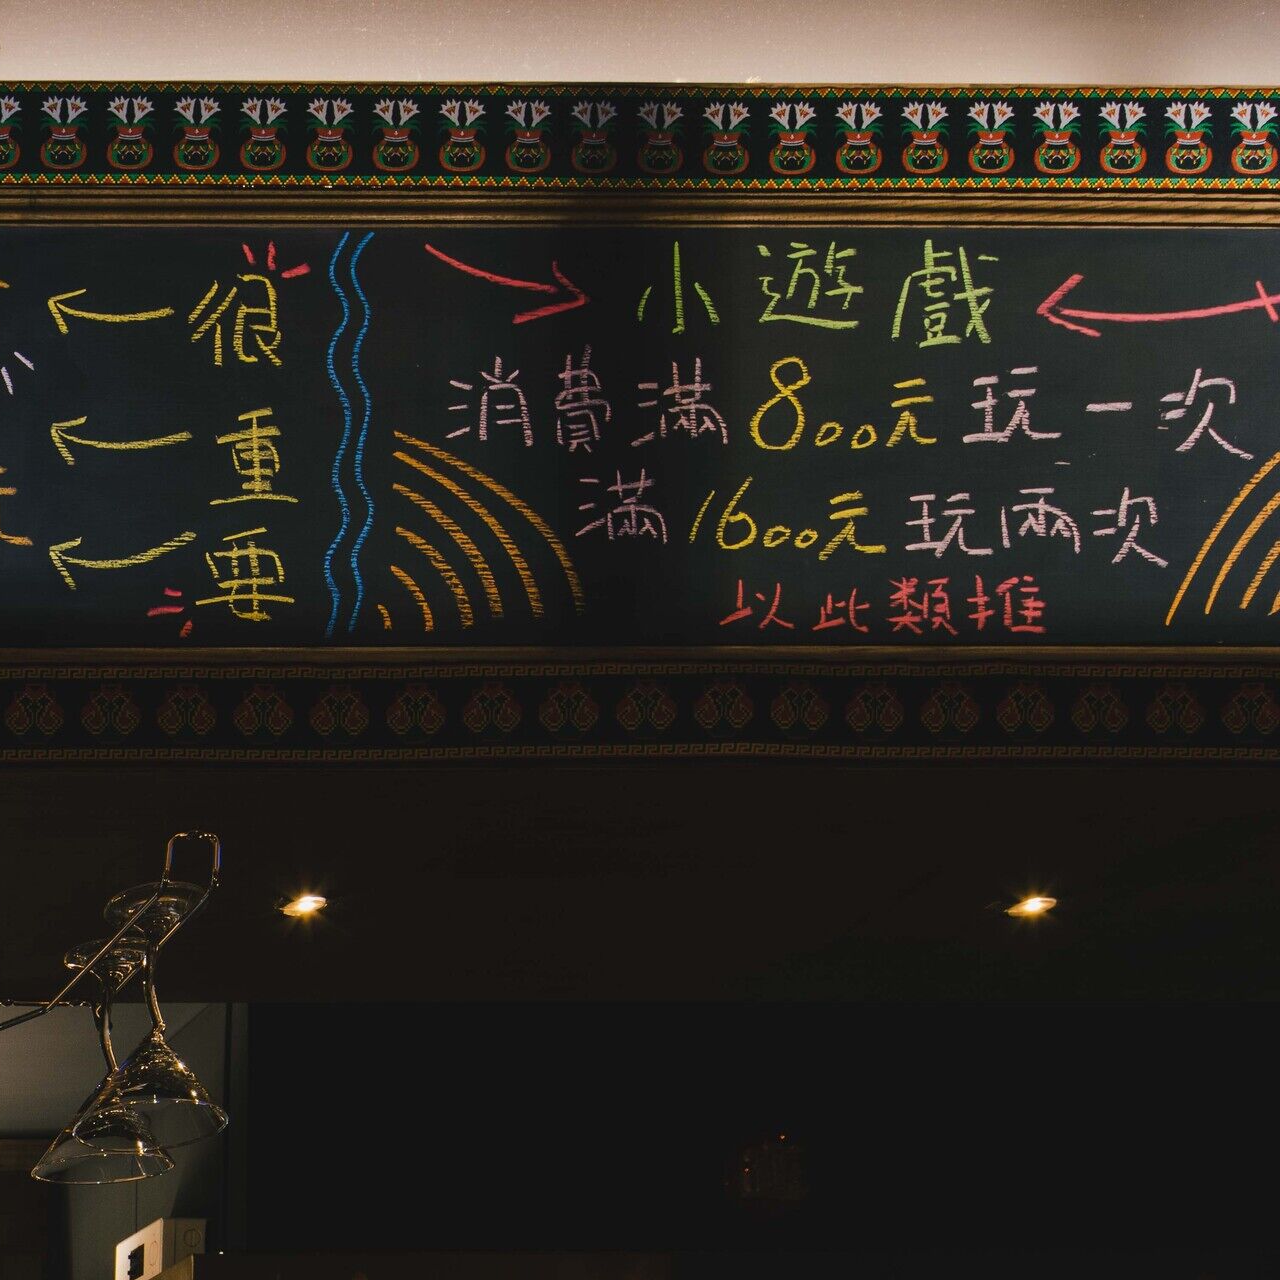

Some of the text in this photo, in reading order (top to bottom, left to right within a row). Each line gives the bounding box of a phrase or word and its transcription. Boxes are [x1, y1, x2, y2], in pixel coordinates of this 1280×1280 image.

[637, 239, 1000, 348] 小遊戲
[718, 575, 1047, 634] 以此類推
